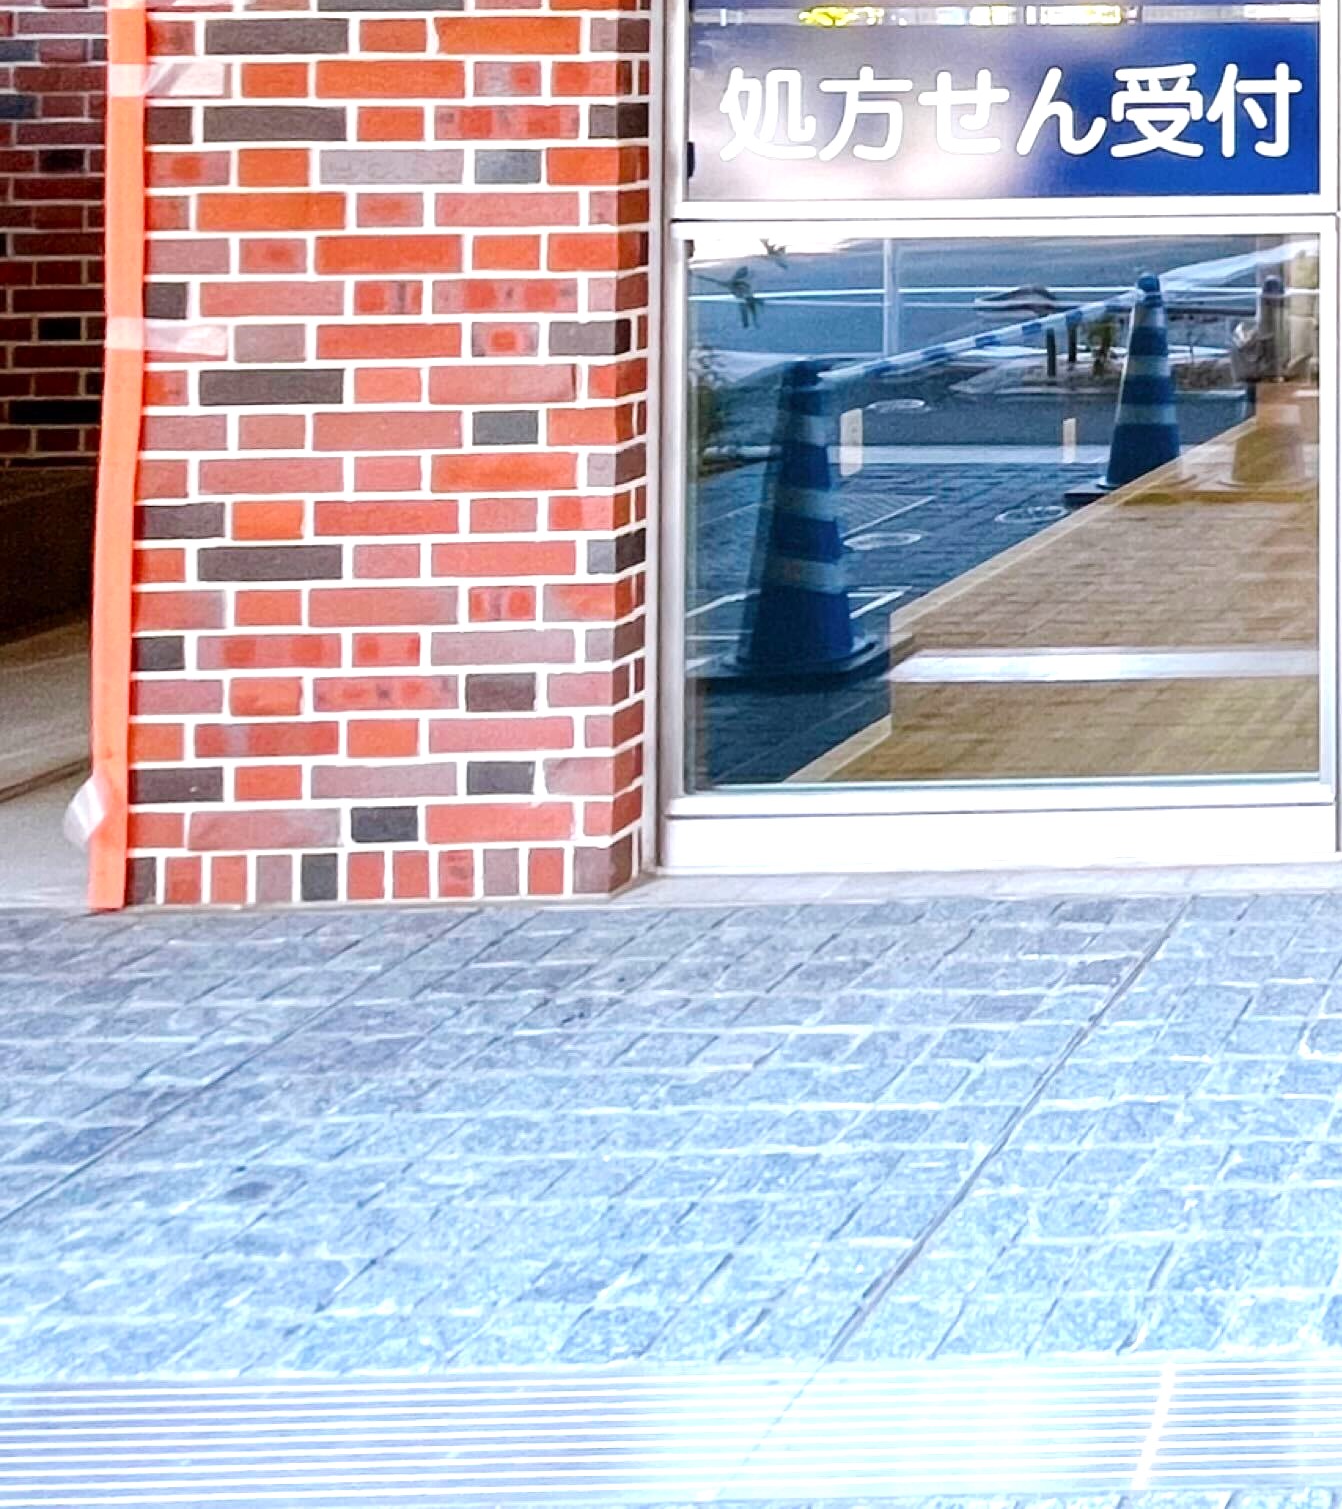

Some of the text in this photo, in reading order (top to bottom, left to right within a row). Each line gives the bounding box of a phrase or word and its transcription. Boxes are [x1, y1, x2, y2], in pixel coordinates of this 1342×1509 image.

[719, 64, 1303, 162] 処方せん受付
